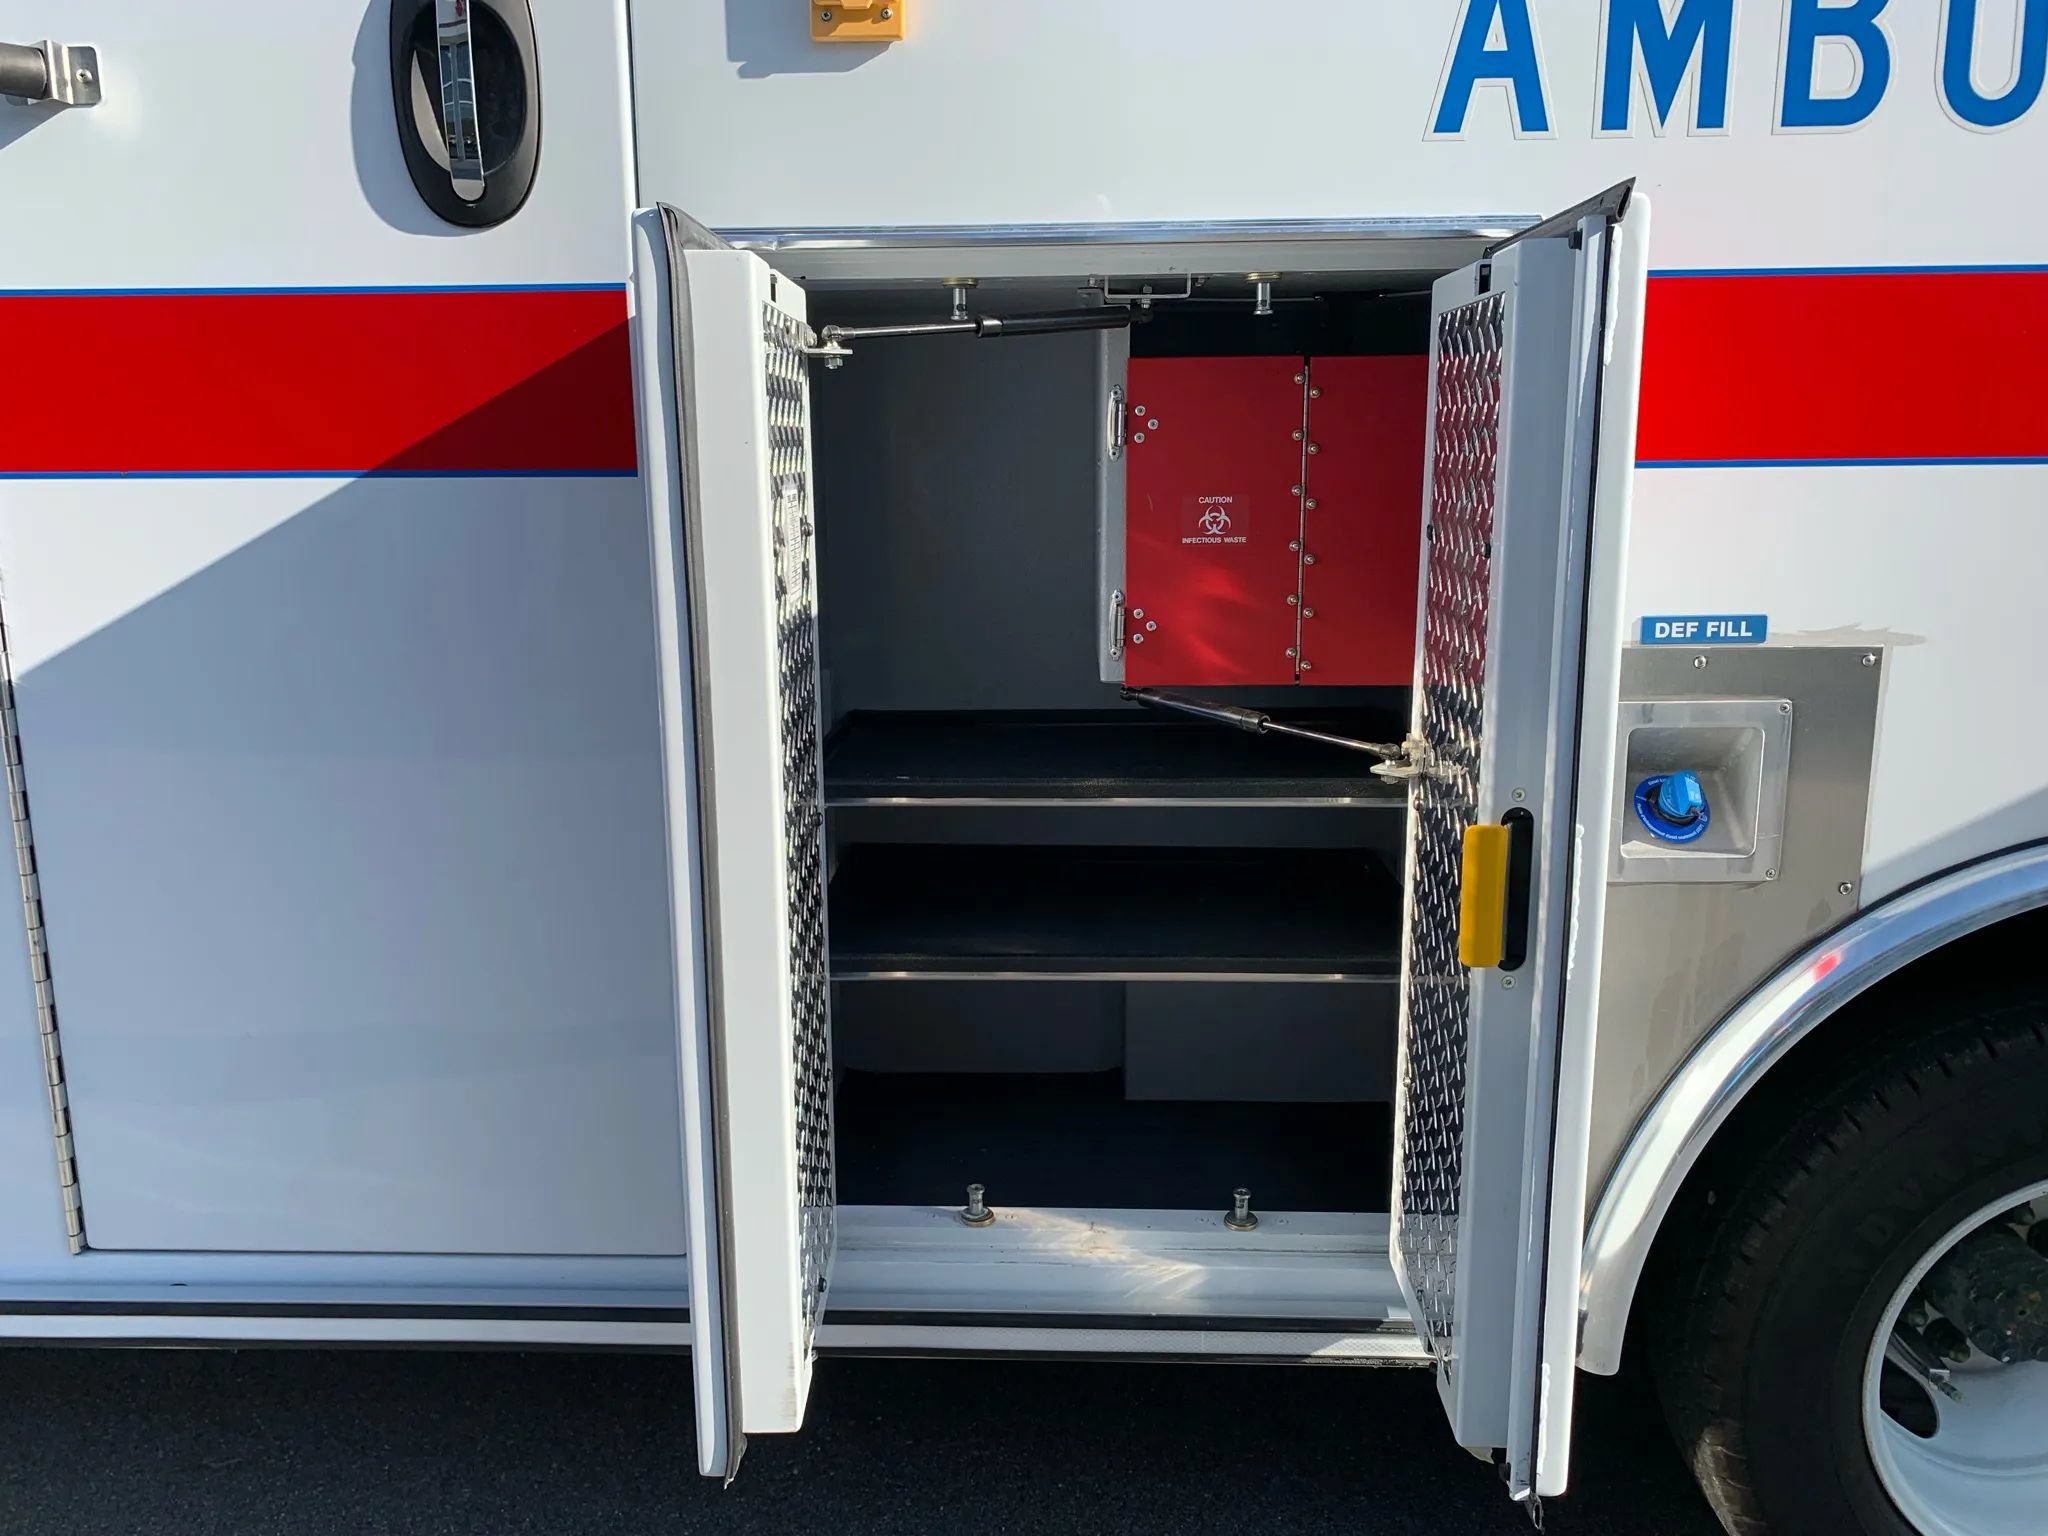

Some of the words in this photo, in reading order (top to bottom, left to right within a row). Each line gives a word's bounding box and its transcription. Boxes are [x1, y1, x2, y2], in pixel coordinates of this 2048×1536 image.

[1198, 496, 1233, 504] CAUTION
[1654, 622, 1699, 639] DEF
[1706, 620, 1753, 638] FILL
